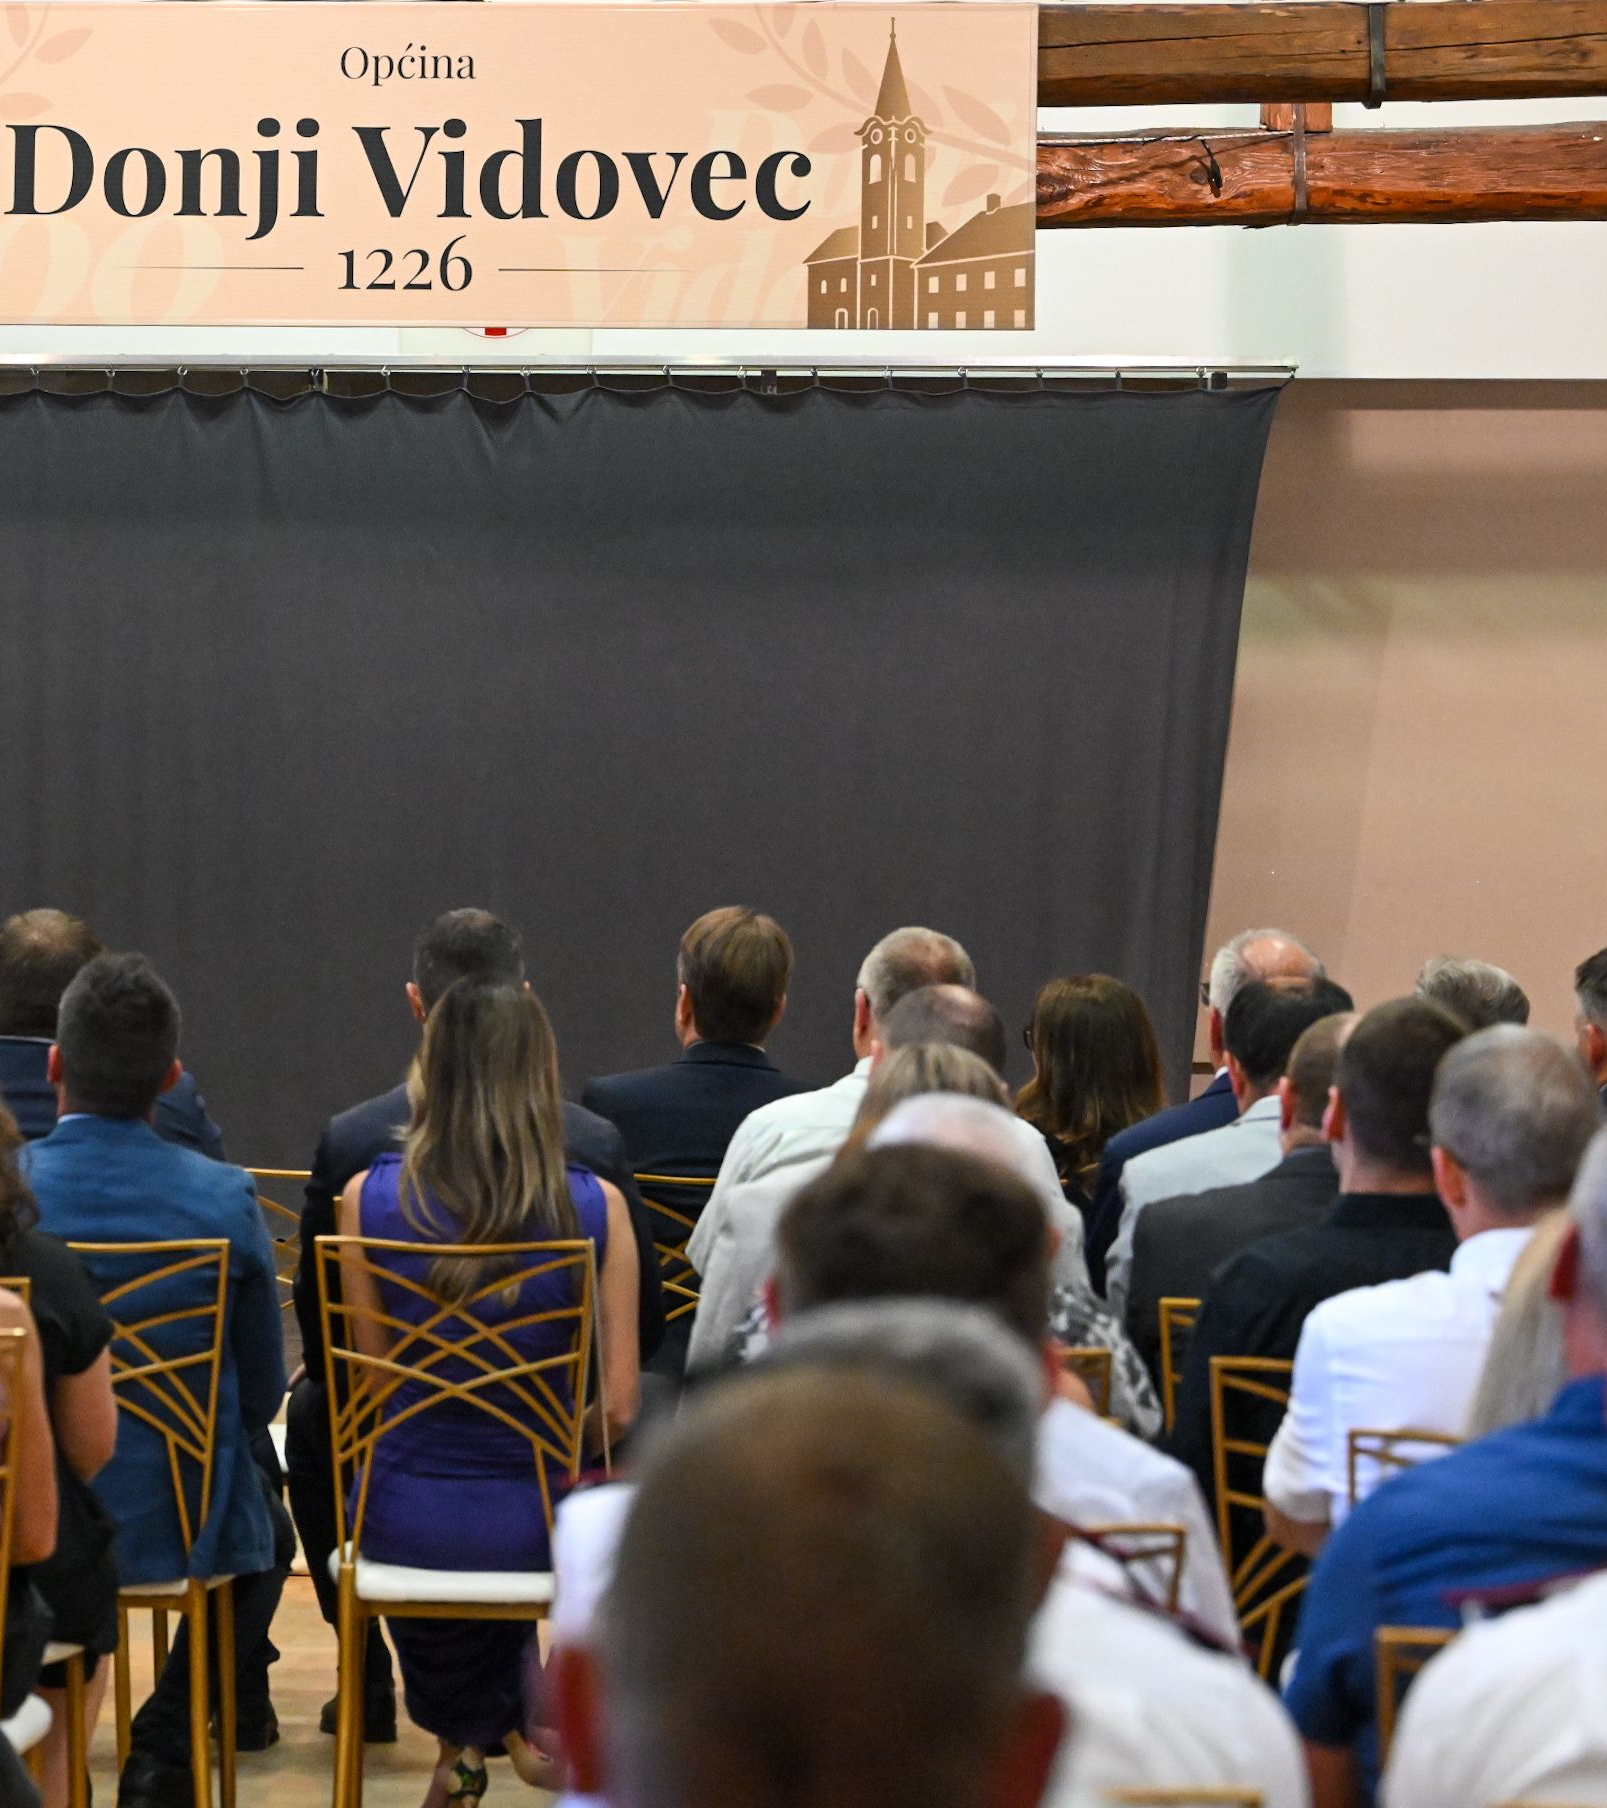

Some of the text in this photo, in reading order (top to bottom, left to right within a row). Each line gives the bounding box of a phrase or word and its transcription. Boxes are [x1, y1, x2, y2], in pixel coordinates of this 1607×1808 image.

[339, 42, 477, 87] Općina
[4, 117, 326, 241] Donji
[351, 117, 813, 222] Vidovec
[336, 235, 474, 292] 1226
